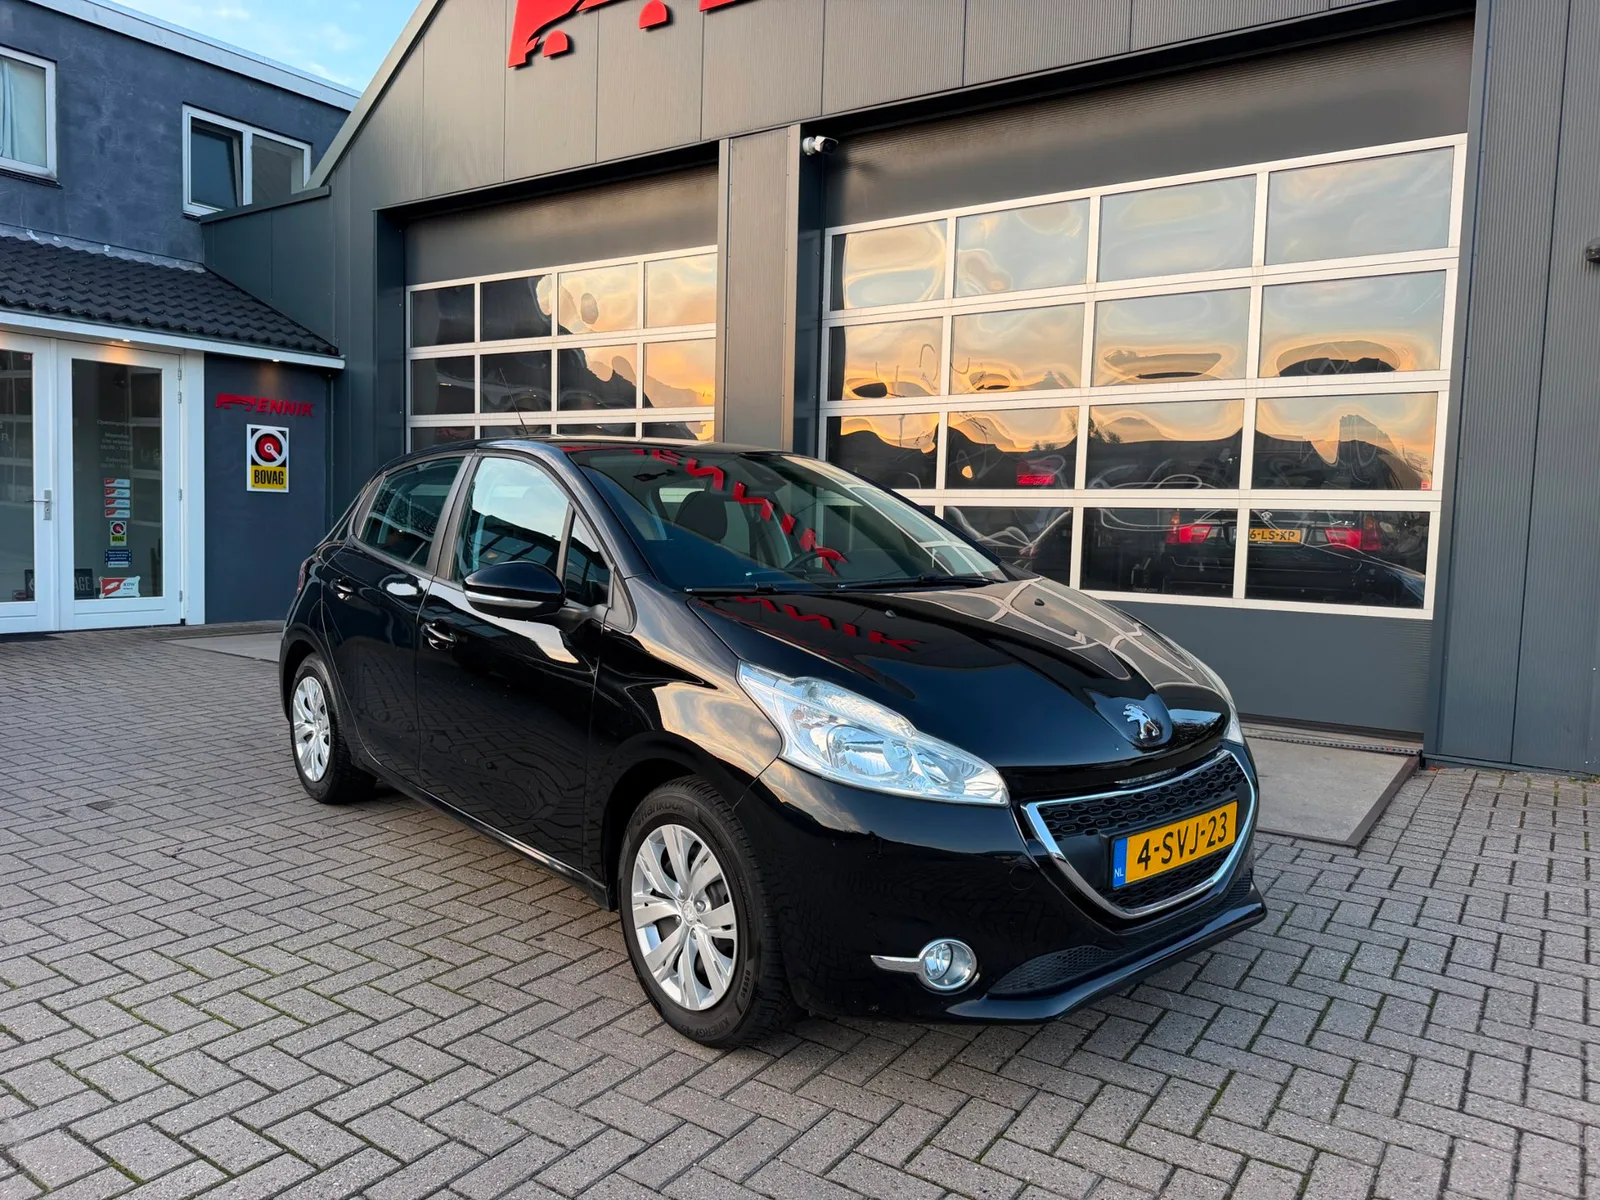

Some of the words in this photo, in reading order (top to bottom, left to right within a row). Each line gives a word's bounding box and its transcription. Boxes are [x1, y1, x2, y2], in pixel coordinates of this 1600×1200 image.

[253, 469, 284, 486] BOVAG
[1136, 811, 1228, 871] 4-SVJ-23
[1114, 867, 1124, 878] NL
